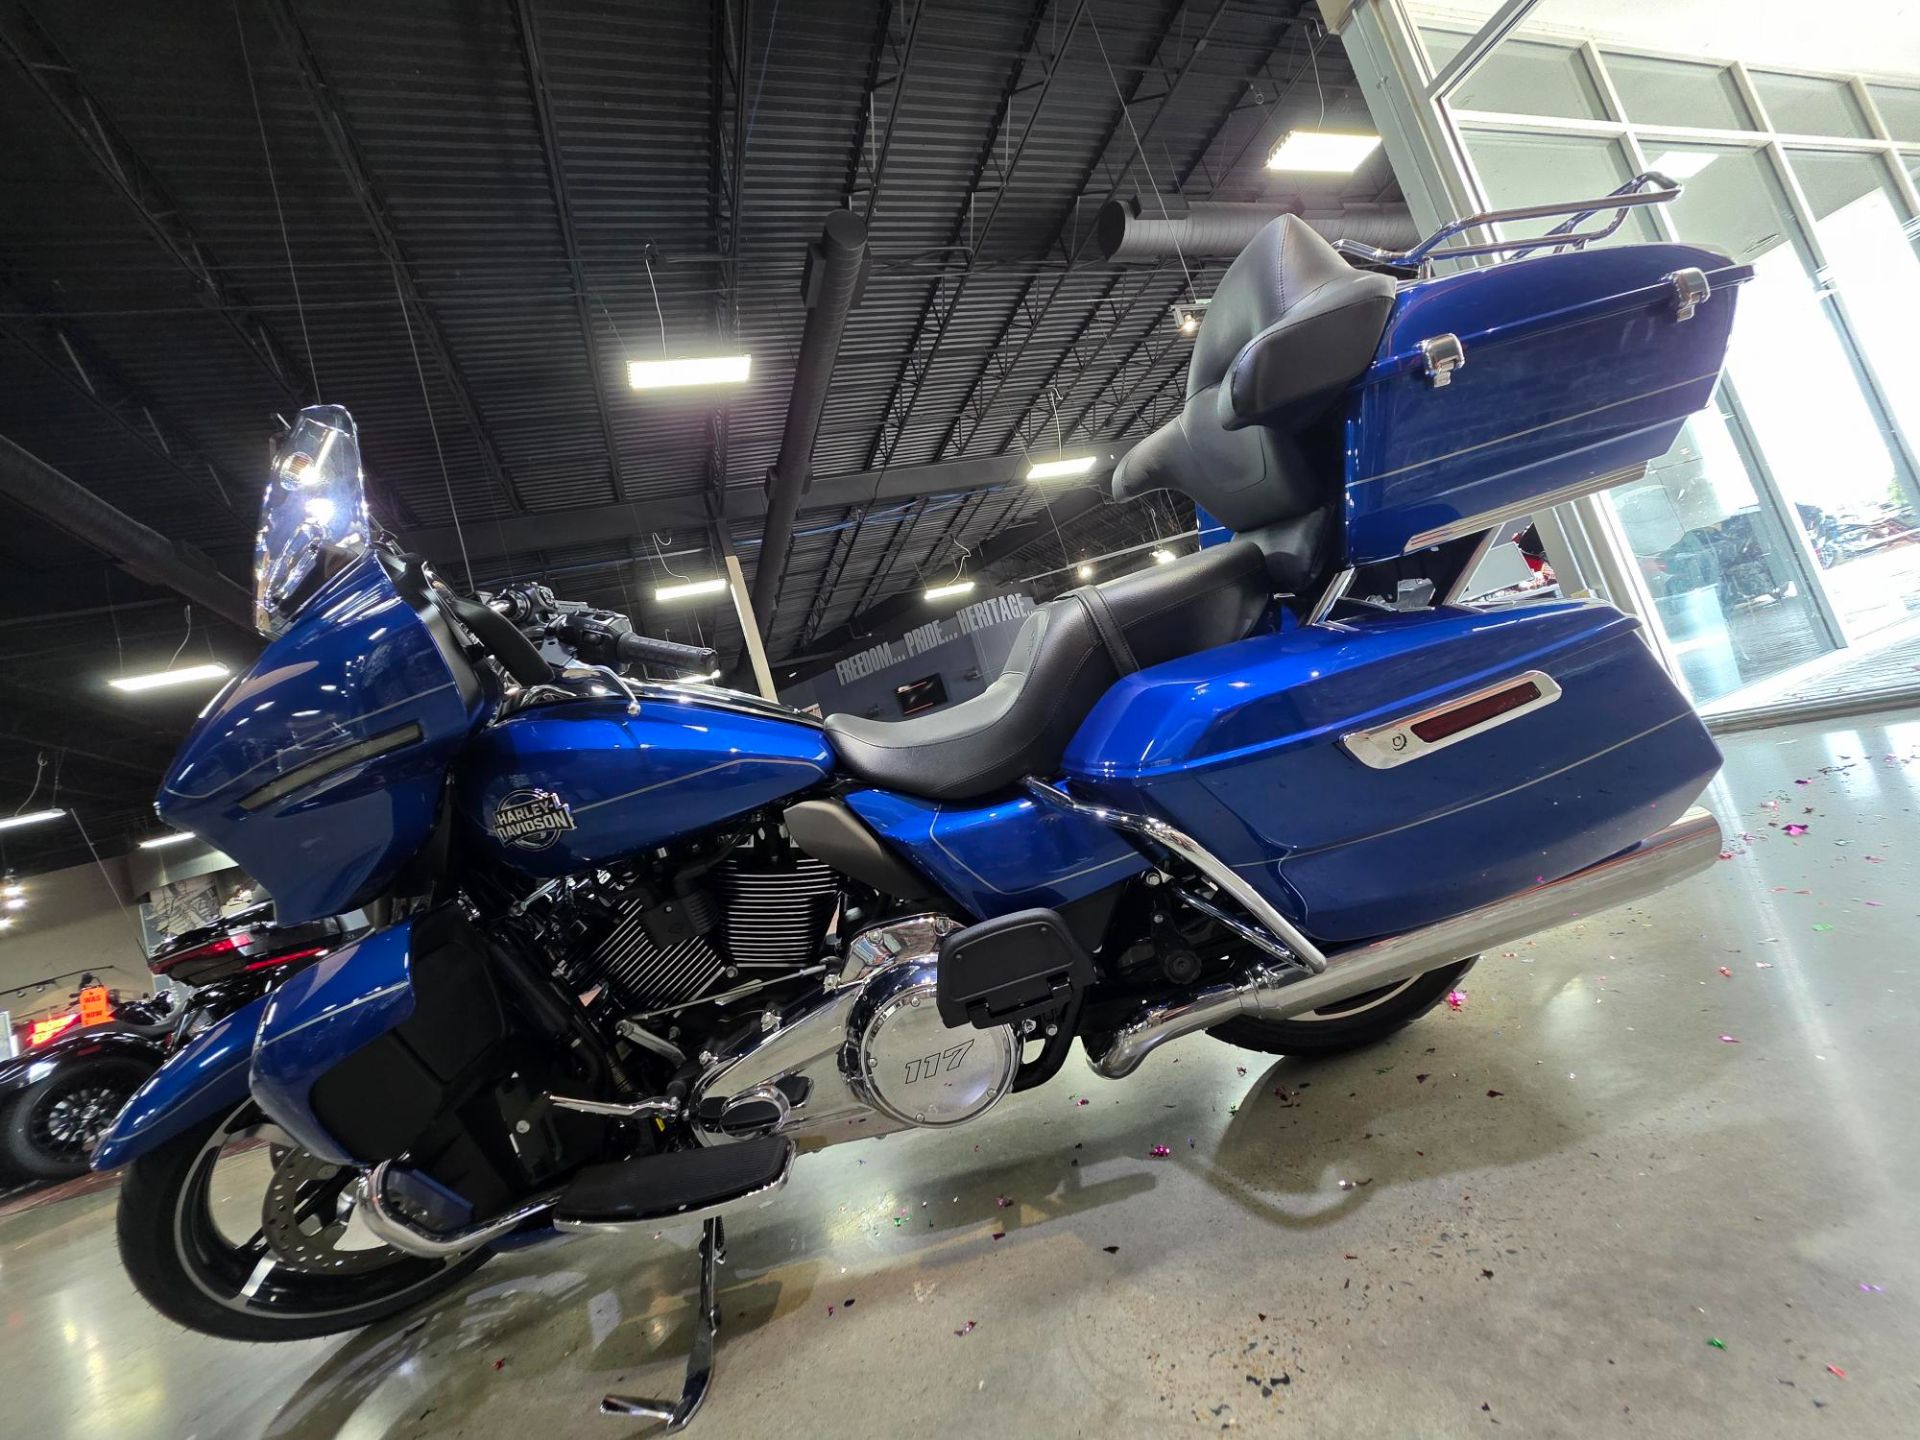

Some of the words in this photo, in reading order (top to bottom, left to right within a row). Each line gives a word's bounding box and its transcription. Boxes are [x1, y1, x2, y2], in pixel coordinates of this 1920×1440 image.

[496, 800, 554, 826] HARLEY-
[496, 810, 569, 843] DAVIDSON
[905, 1038, 975, 1085] 117
